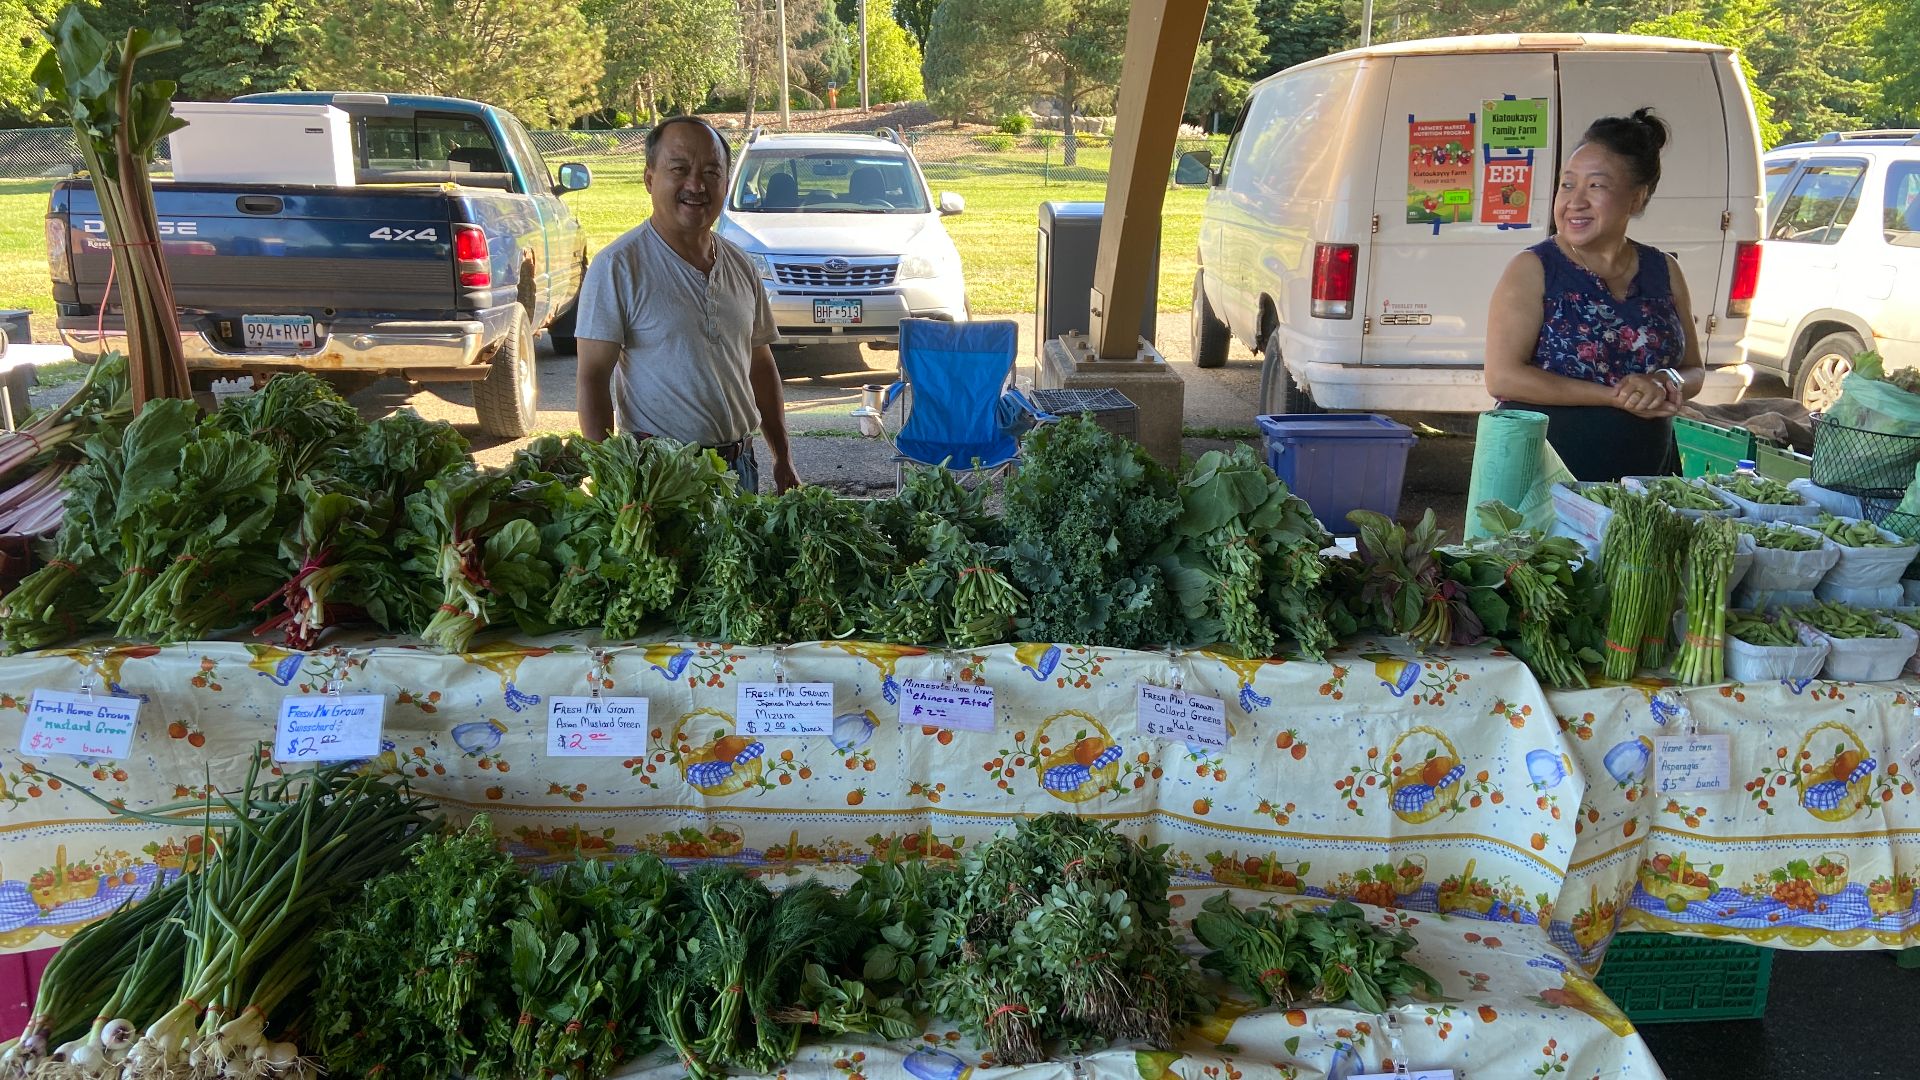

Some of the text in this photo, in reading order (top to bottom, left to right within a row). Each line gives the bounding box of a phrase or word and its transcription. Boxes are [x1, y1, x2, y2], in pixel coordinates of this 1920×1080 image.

[1492, 113, 1537, 123] Kiatoukaysy
[1492, 125, 1537, 135] Family Farm
[1488, 165, 1528, 183] EBT
[84, 220, 198, 235] DGE
[816, 305, 859, 318] BHF 513
[247, 323, 310, 340] 994 RYP
[745, 687, 774, 698] FRESH
[1142, 687, 1166, 702] FRESH
[34, 699, 131, 721] Fresh Home Grown
[331, 704, 366, 717] Grown
[553, 702, 582, 714] FRESH
[606, 702, 635, 714] Grown
[1154, 703, 1222, 726] Collard Greens
[556, 716, 641, 729] Asian Mustard Green
[799, 722, 824, 733] bunch
[1172, 718, 1195, 732] Kale
[1197, 733, 1224, 747] bunch
[1661, 740, 1713, 753] Home Grown
[82, 743, 113, 755] bunch
[1661, 759, 1700, 777] Asparagus
[1695, 775, 1720, 789] bunch
